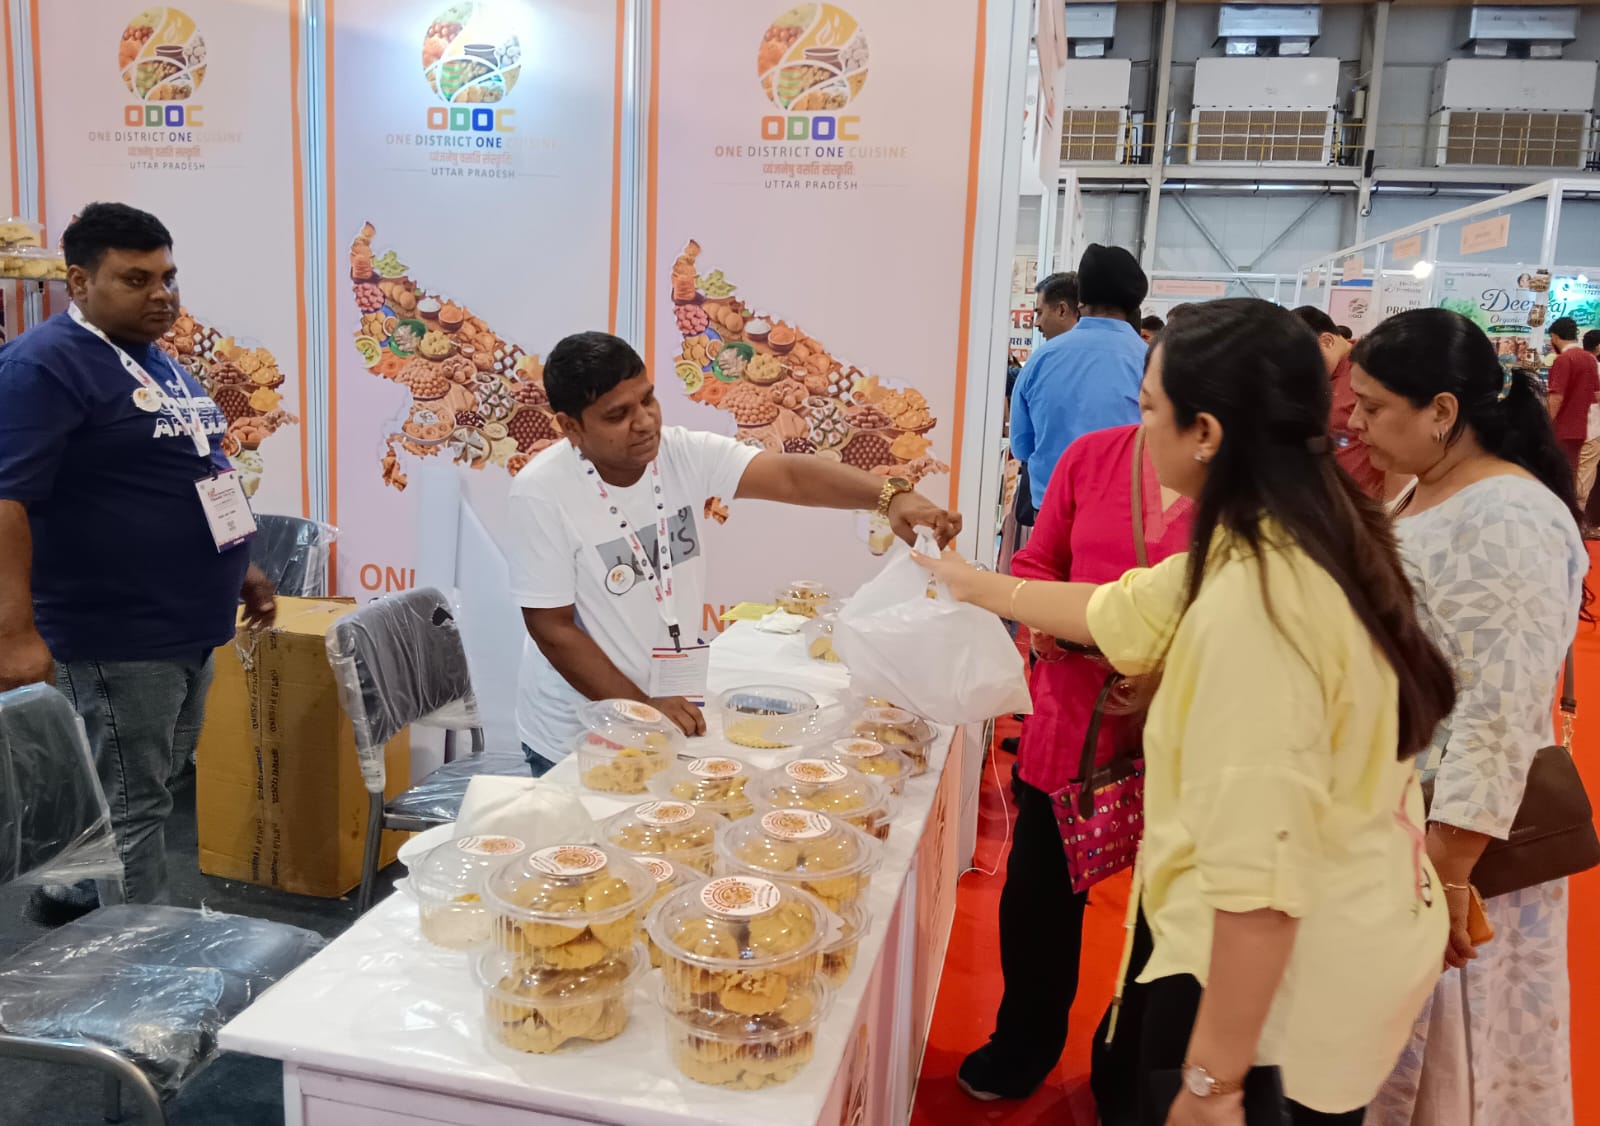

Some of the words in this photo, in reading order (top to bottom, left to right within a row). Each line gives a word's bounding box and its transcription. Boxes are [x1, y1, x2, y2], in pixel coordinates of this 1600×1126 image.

[124, 105, 204, 127] ODOC
[427, 107, 515, 132] ODOC
[761, 115, 861, 141] ODOC
[88, 131, 111, 142] ONE
[114, 132, 165, 142] DISTRICT
[168, 132, 193, 143] ONE
[385, 134, 412, 145] ONE
[415, 135, 472, 147] DISTRICT
[475, 137, 503, 148] ONE
[714, 145, 743, 158] ONE
[747, 146, 811, 158] DISTRICT
[815, 146, 844, 158] ONE
[849, 147, 908, 158] CUISINE
[129, 161, 159, 170] UTTAR
[162, 162, 206, 171] PRADESH
[431, 167, 464, 177] UTTAR
[467, 168, 516, 179] PRADESH
[765, 180, 800, 189] UTTAR
[805, 181, 858, 190] PRADESH
